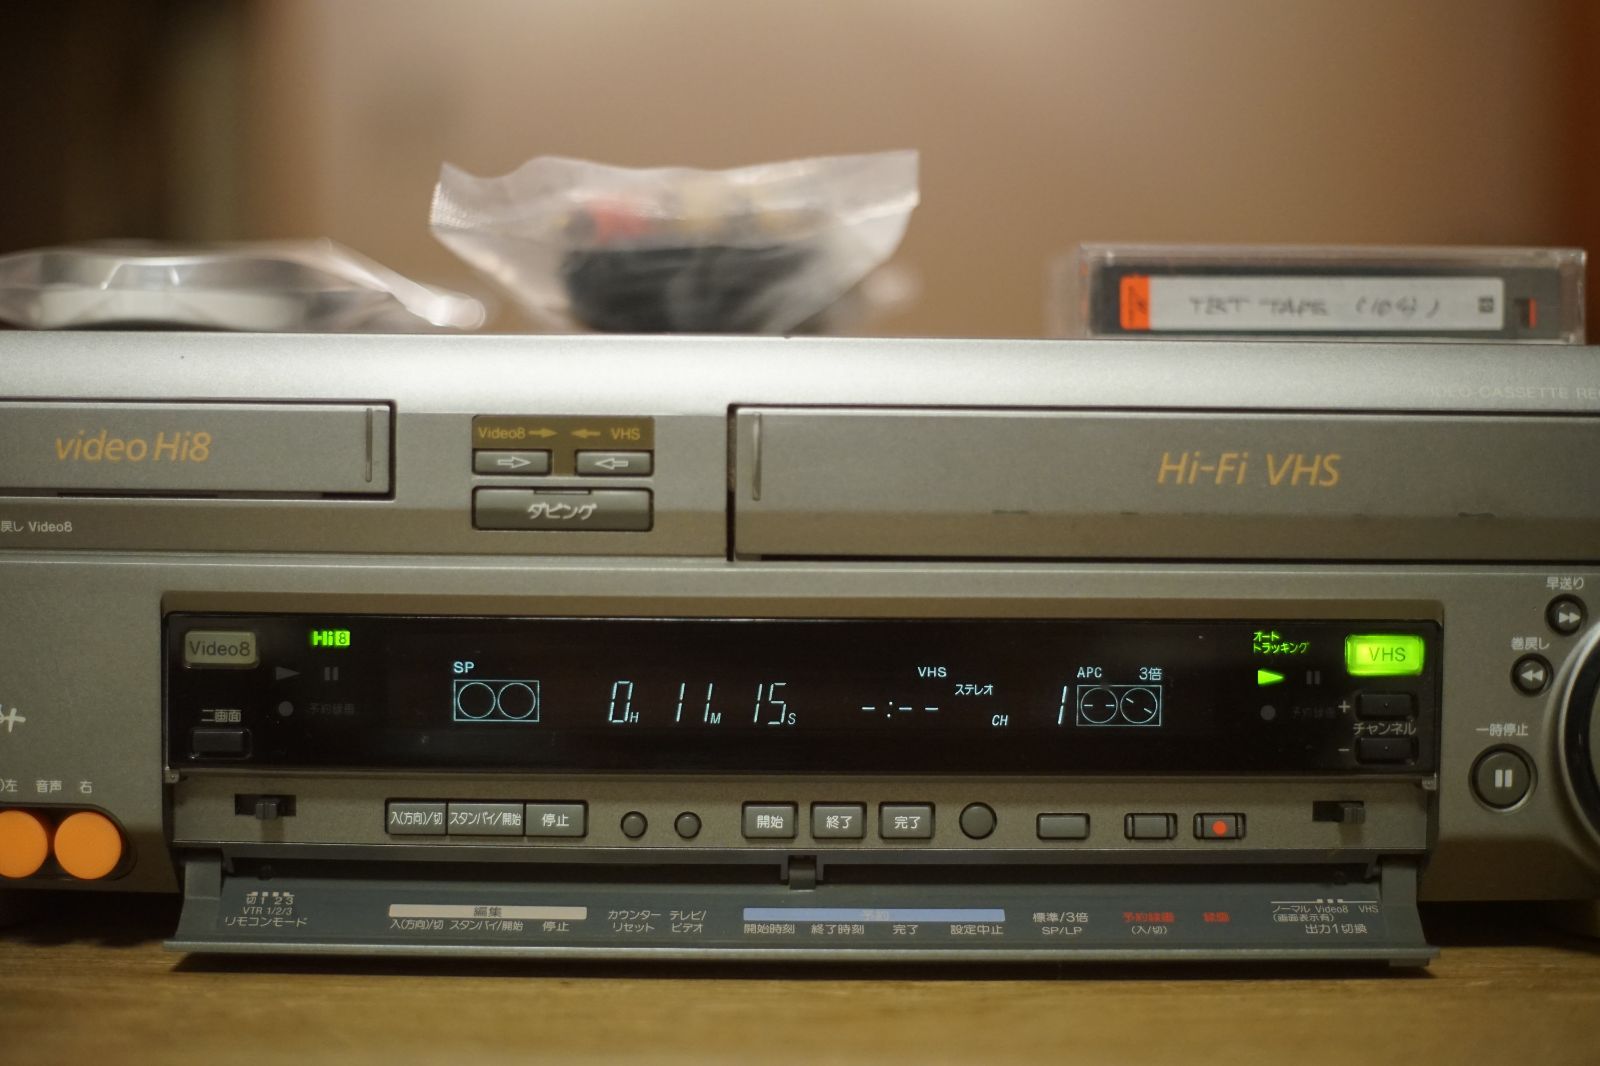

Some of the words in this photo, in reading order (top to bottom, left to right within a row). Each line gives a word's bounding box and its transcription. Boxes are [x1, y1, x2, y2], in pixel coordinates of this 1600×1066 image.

[1260, 297, 1328, 317] TAPE
[1478, 387, 1569, 399] CASSETTE
[478, 427, 526, 440] Video8
[611, 428, 641, 441] VHS
[56, 430, 147, 463] video
[153, 432, 212, 463] Hi8
[1157, 452, 1248, 486] Hi-Fi
[1265, 454, 1341, 487] VHS
[528, 502, 597, 520] ダビング
[28, 520, 73, 533] Video8
[1546, 576, 1585, 591] 早送り
[312, 630, 350, 646] Hi8
[1253, 631, 1280, 642] オート
[189, 641, 250, 657] Video8
[1253, 642, 1310, 654] トラッキング
[1511, 636, 1550, 651] 巻戻し
[1368, 647, 1407, 662] VHS
[453, 661, 475, 674] SP
[917, 666, 948, 678] VHS
[1077, 666, 1103, 678] APC
[1139, 667, 1163, 681] 3倍
[954, 684, 994, 696] ステレオ
[201, 708, 242, 723] 二画面
[991, 714, 1009, 727] CH
[1353, 722, 1417, 736] チャンネル
[1475, 723, 1529, 737] 一時停止
[36, 779, 62, 793] 音声
[80, 780, 93, 794] 右
[390, 811, 443, 826] 入(方向)/切
[450, 811, 522, 827] スタンバイ/開始
[541, 813, 570, 828] 停止
[756, 814, 784, 829] 開始
[826, 814, 853, 829] 終了
[894, 815, 921, 829] 完了
[242, 906, 263, 916] VTR
[267, 906, 293, 916] 1/2/3
[608, 910, 661, 921] カウンター
[669, 910, 707, 921] テレビ/
[1315, 904, 1349, 914] Video8
[1358, 905, 1380, 914] VHS
[224, 916, 308, 928] リモコンモード
[1032, 911, 1089, 923] 標準/3倍
[390, 919, 444, 930] 入(方向)/切
[450, 920, 523, 932] スタンバイ/開始
[542, 921, 570, 932] 停止
[612, 922, 655, 933] リセット
[671, 923, 704, 933] ビデオ
[743, 923, 796, 935] 開始時刻
[811, 923, 865, 935] 終了時刻
[892, 924, 919, 935] 完了
[950, 924, 1004, 935] 設定中止
[1041, 926, 1083, 936] SP/LP
[1305, 923, 1368, 935] 出力1切換
